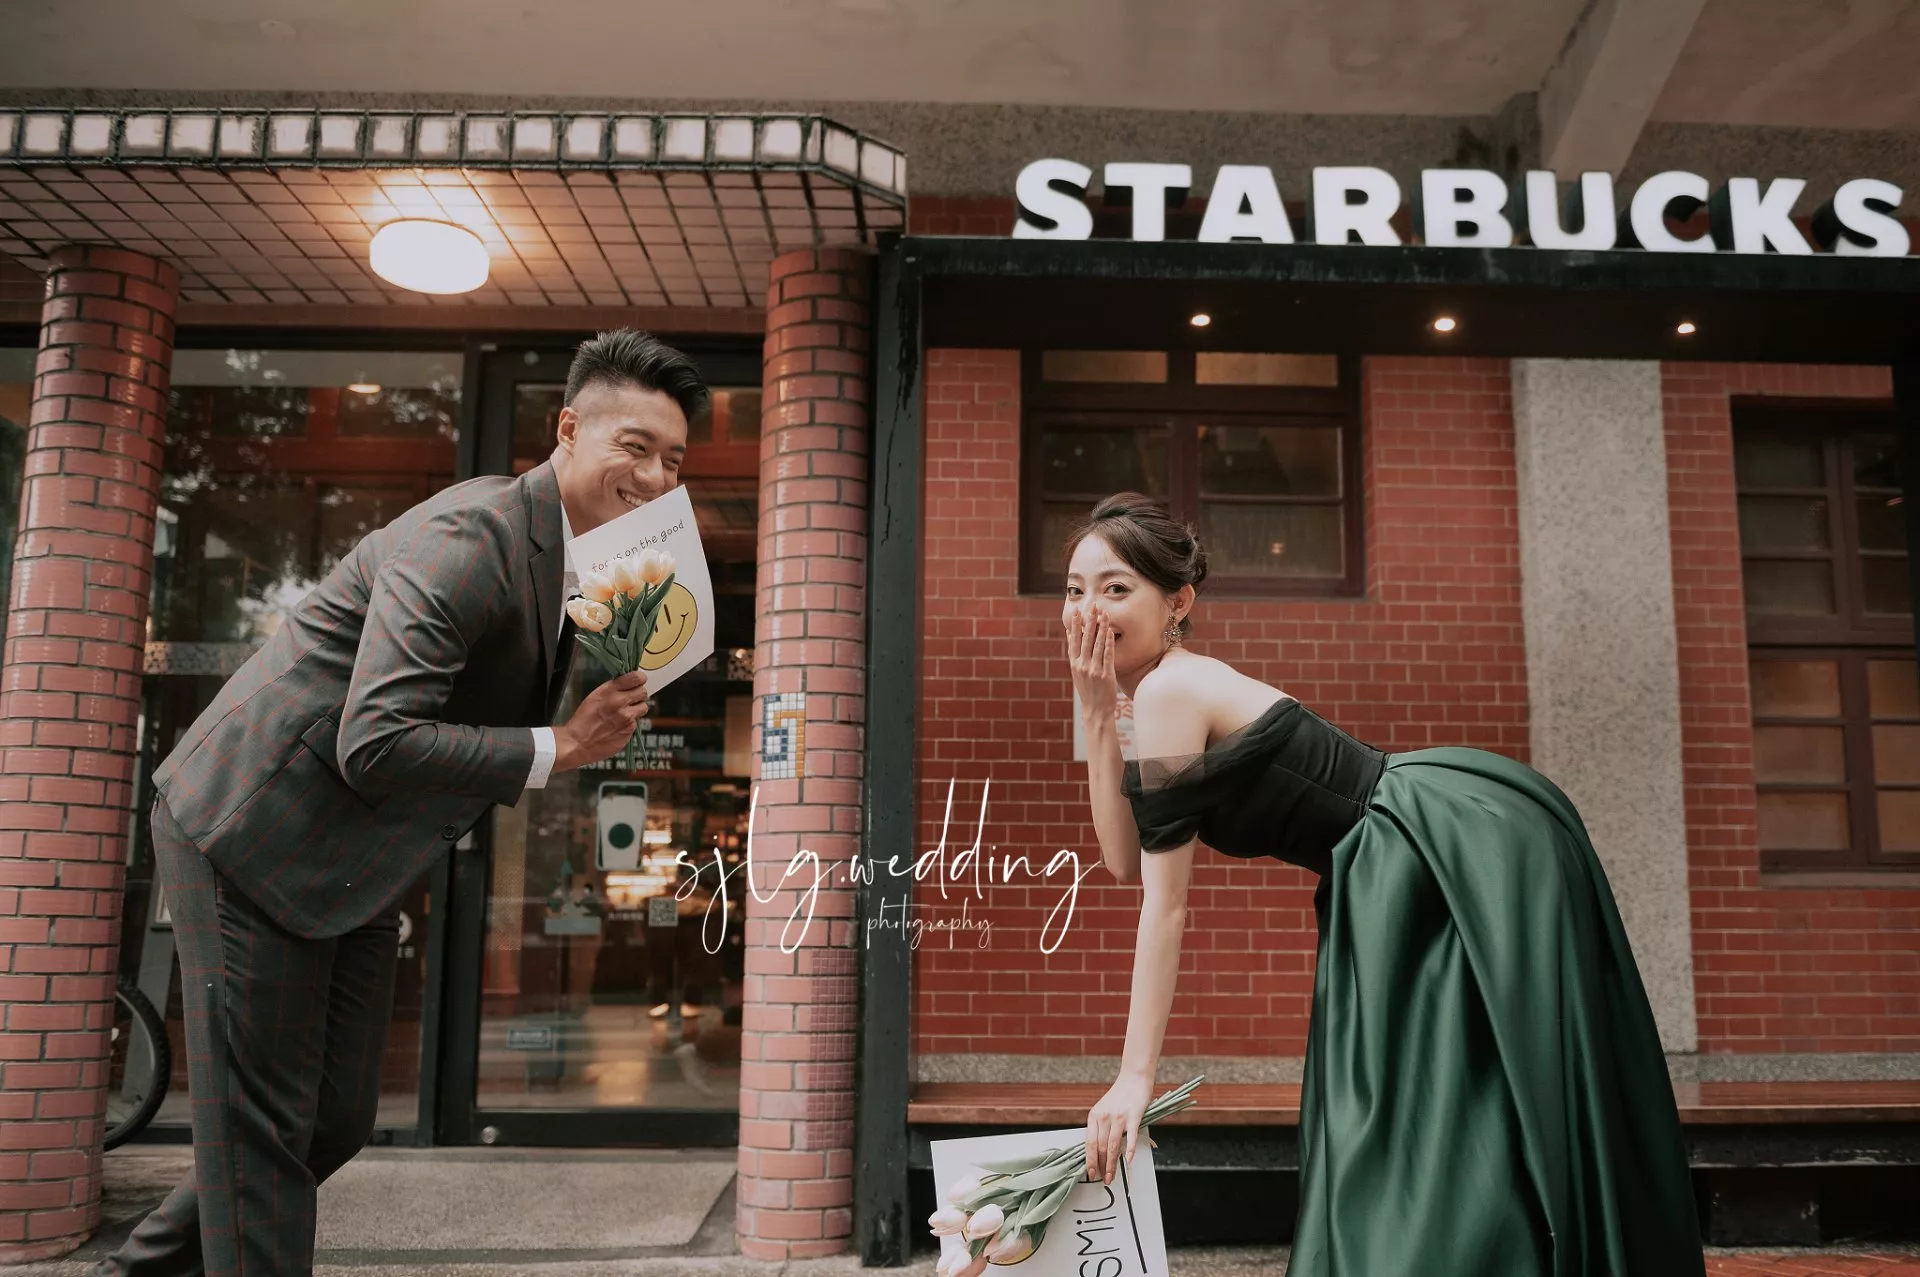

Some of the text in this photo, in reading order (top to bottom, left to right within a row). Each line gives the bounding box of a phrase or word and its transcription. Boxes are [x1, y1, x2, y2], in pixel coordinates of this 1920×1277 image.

[1013, 158, 1910, 256] STARBUCKS
[591, 519, 685, 573] focs on the good
[579, 760, 612, 770] ORE
